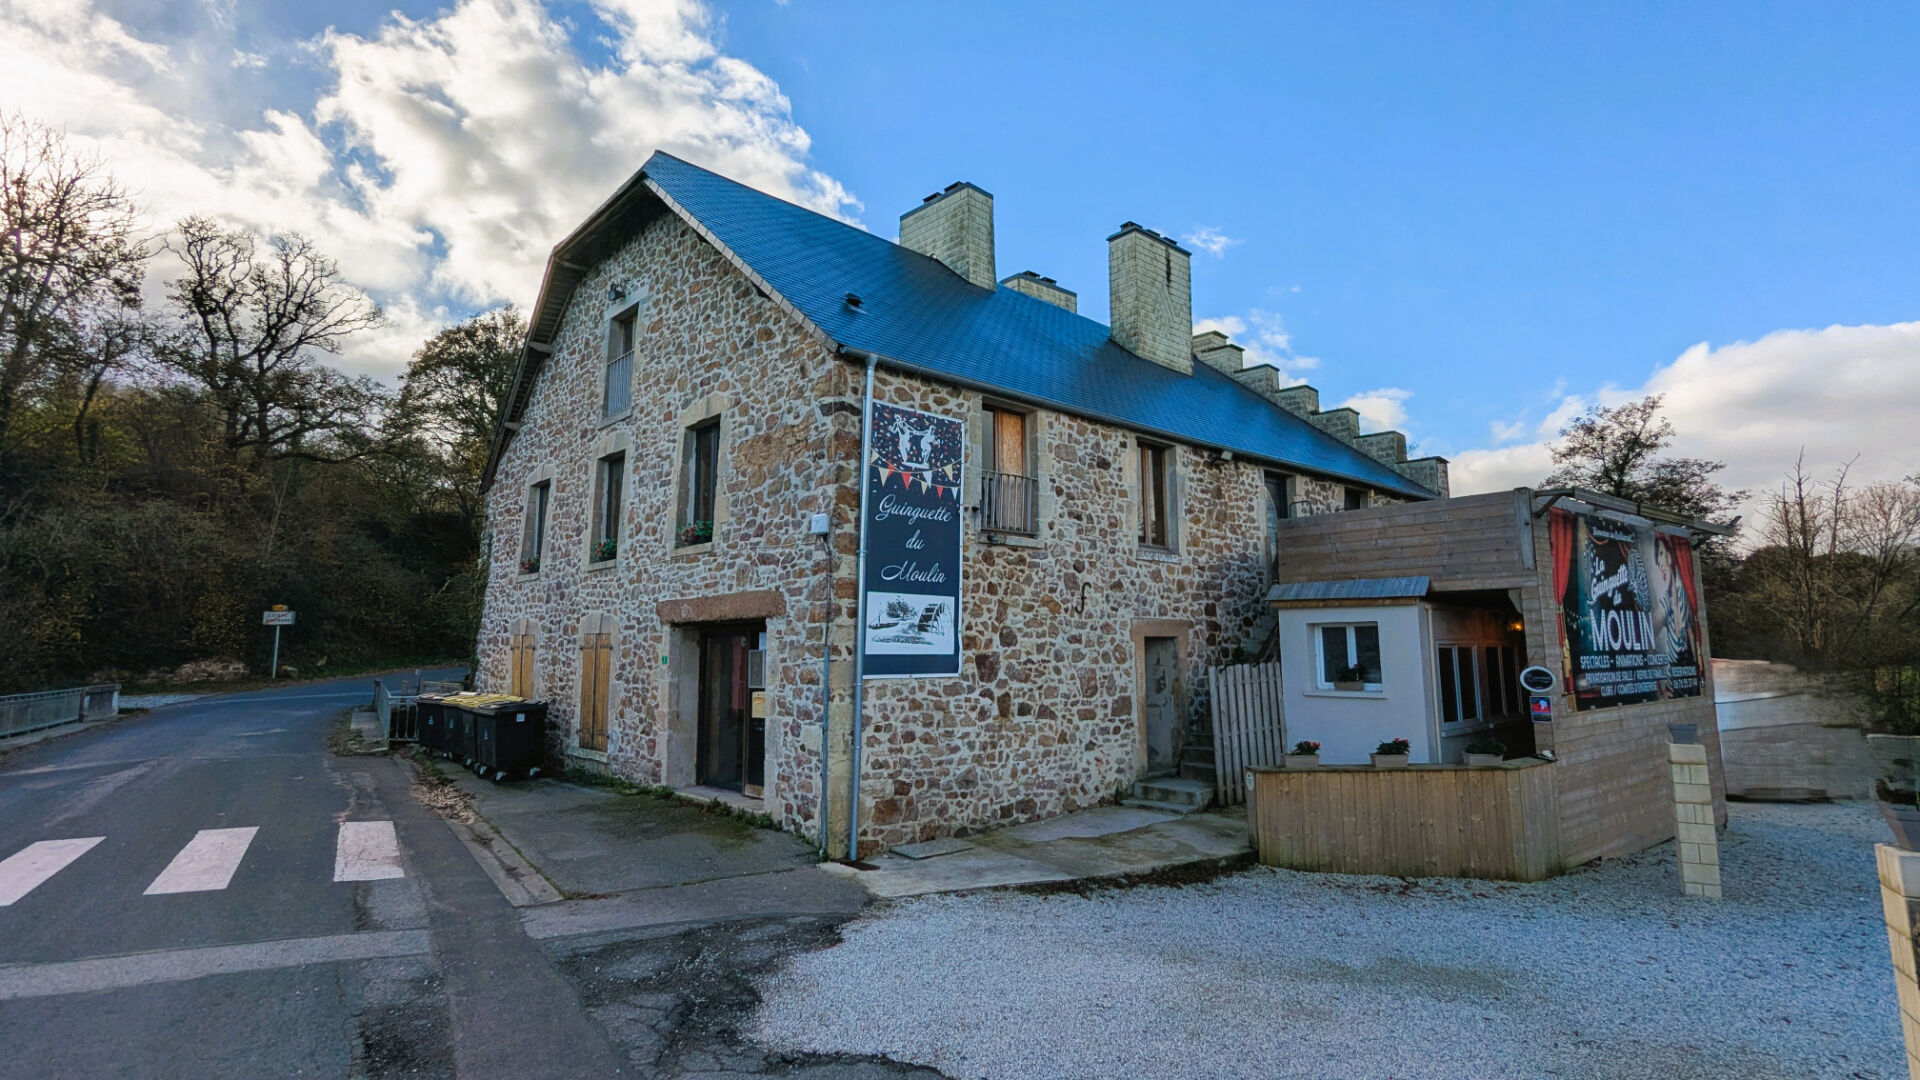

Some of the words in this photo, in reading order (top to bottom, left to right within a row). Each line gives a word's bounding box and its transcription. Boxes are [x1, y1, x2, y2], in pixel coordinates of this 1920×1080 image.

[875, 494, 952, 525] Guinguette
[906, 529, 925, 549] du
[881, 560, 947, 583] Moulin
[1594, 556, 1605, 576] La
[1587, 563, 1629, 605] Guinguette
[1613, 589, 1622, 606] du
[1589, 608, 1656, 652] MOULIN
[1579, 655, 1610, 669] SPECTACLES
[1616, 654, 1643, 667] ANIMATIONS
